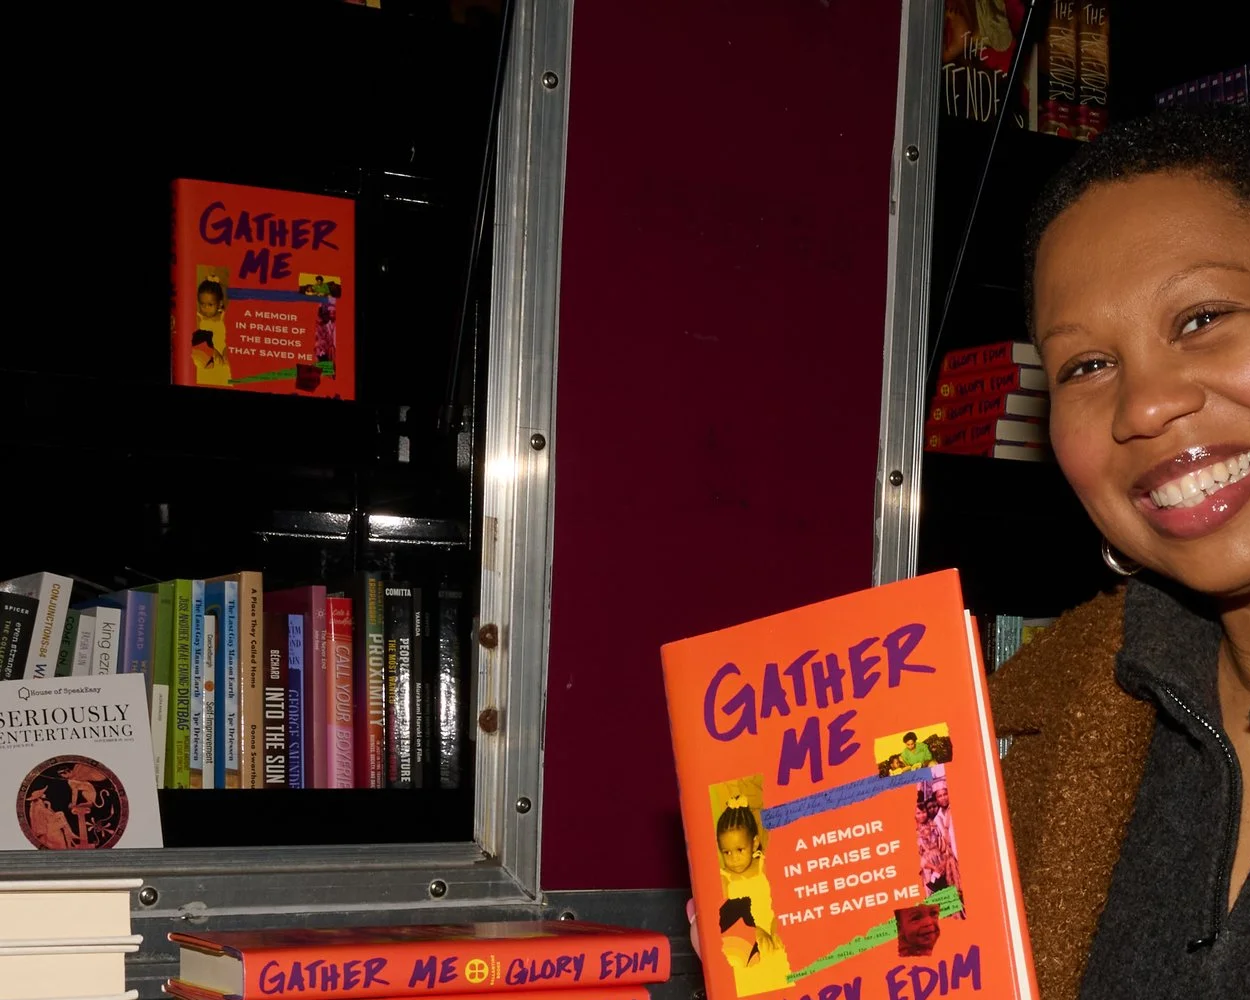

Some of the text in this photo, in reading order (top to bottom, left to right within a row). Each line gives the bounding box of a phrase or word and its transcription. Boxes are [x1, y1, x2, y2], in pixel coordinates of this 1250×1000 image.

[961, 30, 989, 61] THE
[200, 201, 339, 251] GATHER
[239, 248, 292, 285] ME
[235, 322, 306, 335] IN PRAISE OF
[244, 310, 298, 322] A MEMOIR
[228, 346, 313, 361] THAT SAVED ME
[240, 334, 301, 347] THE BOOKS
[4, 604, 30, 615] SPICER
[385, 587, 412, 598] COMITTA
[12, 621, 22, 642] even
[39, 583, 61, 658] CONJUNCTIONS:84
[97, 621, 116, 649] king
[59, 616, 75, 665] COME ON
[193, 633, 201, 646] Gay
[227, 633, 235, 647] Gay
[388, 639, 397, 653] THE
[368, 633, 384, 727] PROXIMITY
[387, 654, 397, 674] MOST
[31, 689, 53, 697] House
[63, 687, 101, 696] SpeakEasy
[704, 624, 936, 742] GATHER
[177, 688, 190, 731] DIRTBAG
[265, 650, 285, 783] BÉCHARD INTO THE SUN
[335, 645, 352, 788] CALL YOUR BOYFRIE
[205, 702, 214, 764] Self-Improvement
[777, 710, 860, 786] ME
[288, 742, 300, 789] SAUNDE
[795, 819, 884, 852] A MEMOIR
[784, 840, 901, 877] IN PRAISE OF
[794, 864, 897, 898] THE BOOKS
[778, 885, 920, 927] THAT SAVED ME
[259, 946, 659, 995] GATHER ME GLORY EDIM
